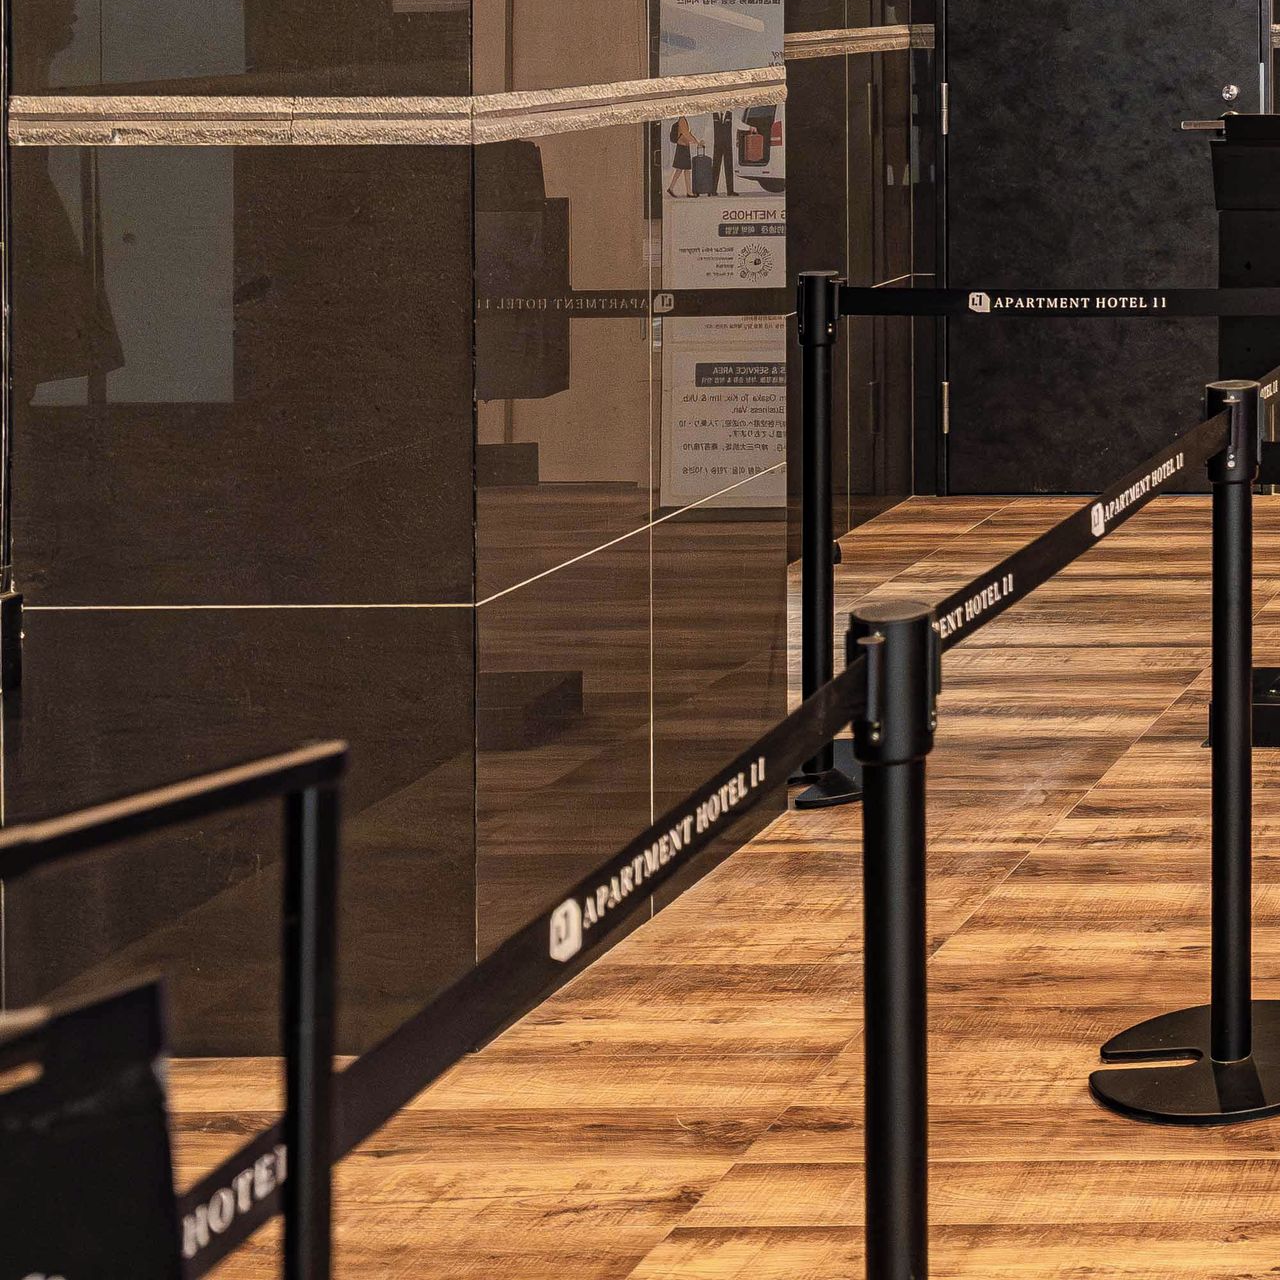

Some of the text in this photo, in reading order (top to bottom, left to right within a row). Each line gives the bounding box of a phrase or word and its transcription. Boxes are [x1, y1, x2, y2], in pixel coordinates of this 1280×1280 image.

[994, 297, 1167, 308] APARTMENT HOTEL 11
[1103, 452, 1184, 522] APARTMENT HOTEL 11
[964, 581, 1002, 621] HOTEL
[1002, 573, 1014, 596] 11
[582, 756, 766, 930] APARTMENT HOTEL 11
